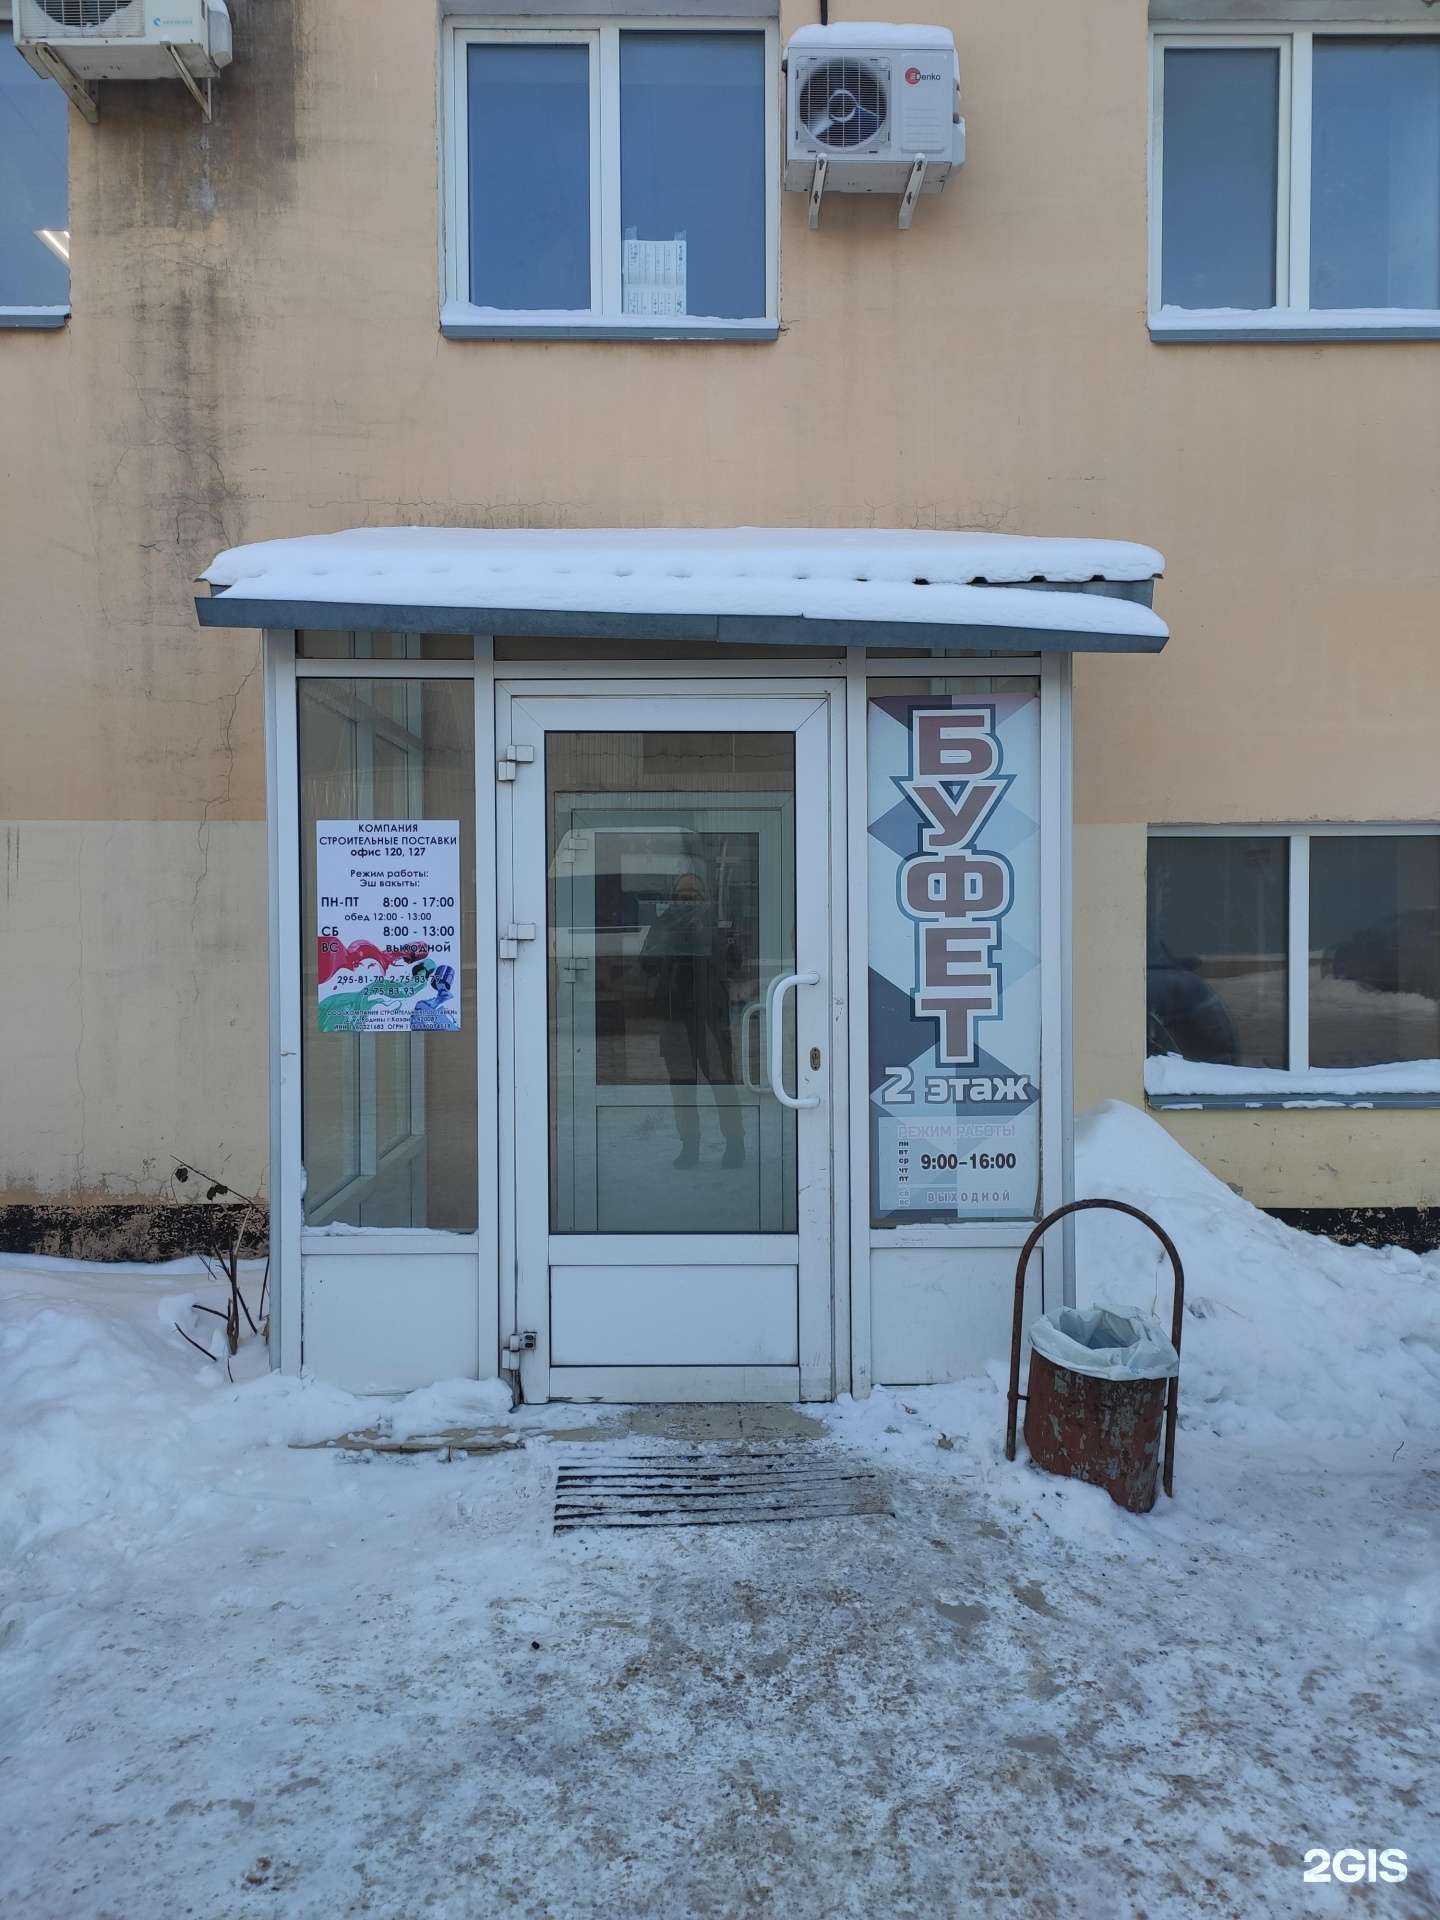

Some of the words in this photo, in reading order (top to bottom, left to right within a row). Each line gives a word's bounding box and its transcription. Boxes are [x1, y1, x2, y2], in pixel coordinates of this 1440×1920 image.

[358, 823, 418, 833] КОМПАНИЯ
[319, 836, 399, 846] СТРОИТЕЛЬНЫЕ
[401, 836, 457, 846] ПОСТАВКИ
[350, 847, 381, 858] офис
[384, 847, 405, 858] 120,
[408, 847, 426, 857] 127
[350, 869, 385, 878] Режим
[387, 869, 429, 879] работы:
[359, 879, 377, 888] Эш
[900, 708, 1010, 1063] БУФЕТ
[321, 896, 359, 907] ПН-ПТ
[382, 896, 409, 908] 8:00
[422, 896, 455, 908] 17:00
[344, 912, 370, 922] обед
[373, 912, 398, 921] 12:00
[407, 912, 432, 921] 13:00
[321, 926, 339, 937] СБ
[383, 926, 409, 937] 8:00
[422, 926, 455, 937] 13:00
[321, 942, 338, 953] ВС
[883, 1066, 914, 1104] 2
[926, 1076, 1030, 1103] этаж
[957, 1124, 1016, 1138] РАБОТЫ
[898, 1140, 910, 1148] пн
[898, 1157, 910, 1165] ср
[898, 1175, 910, 1183] пт
